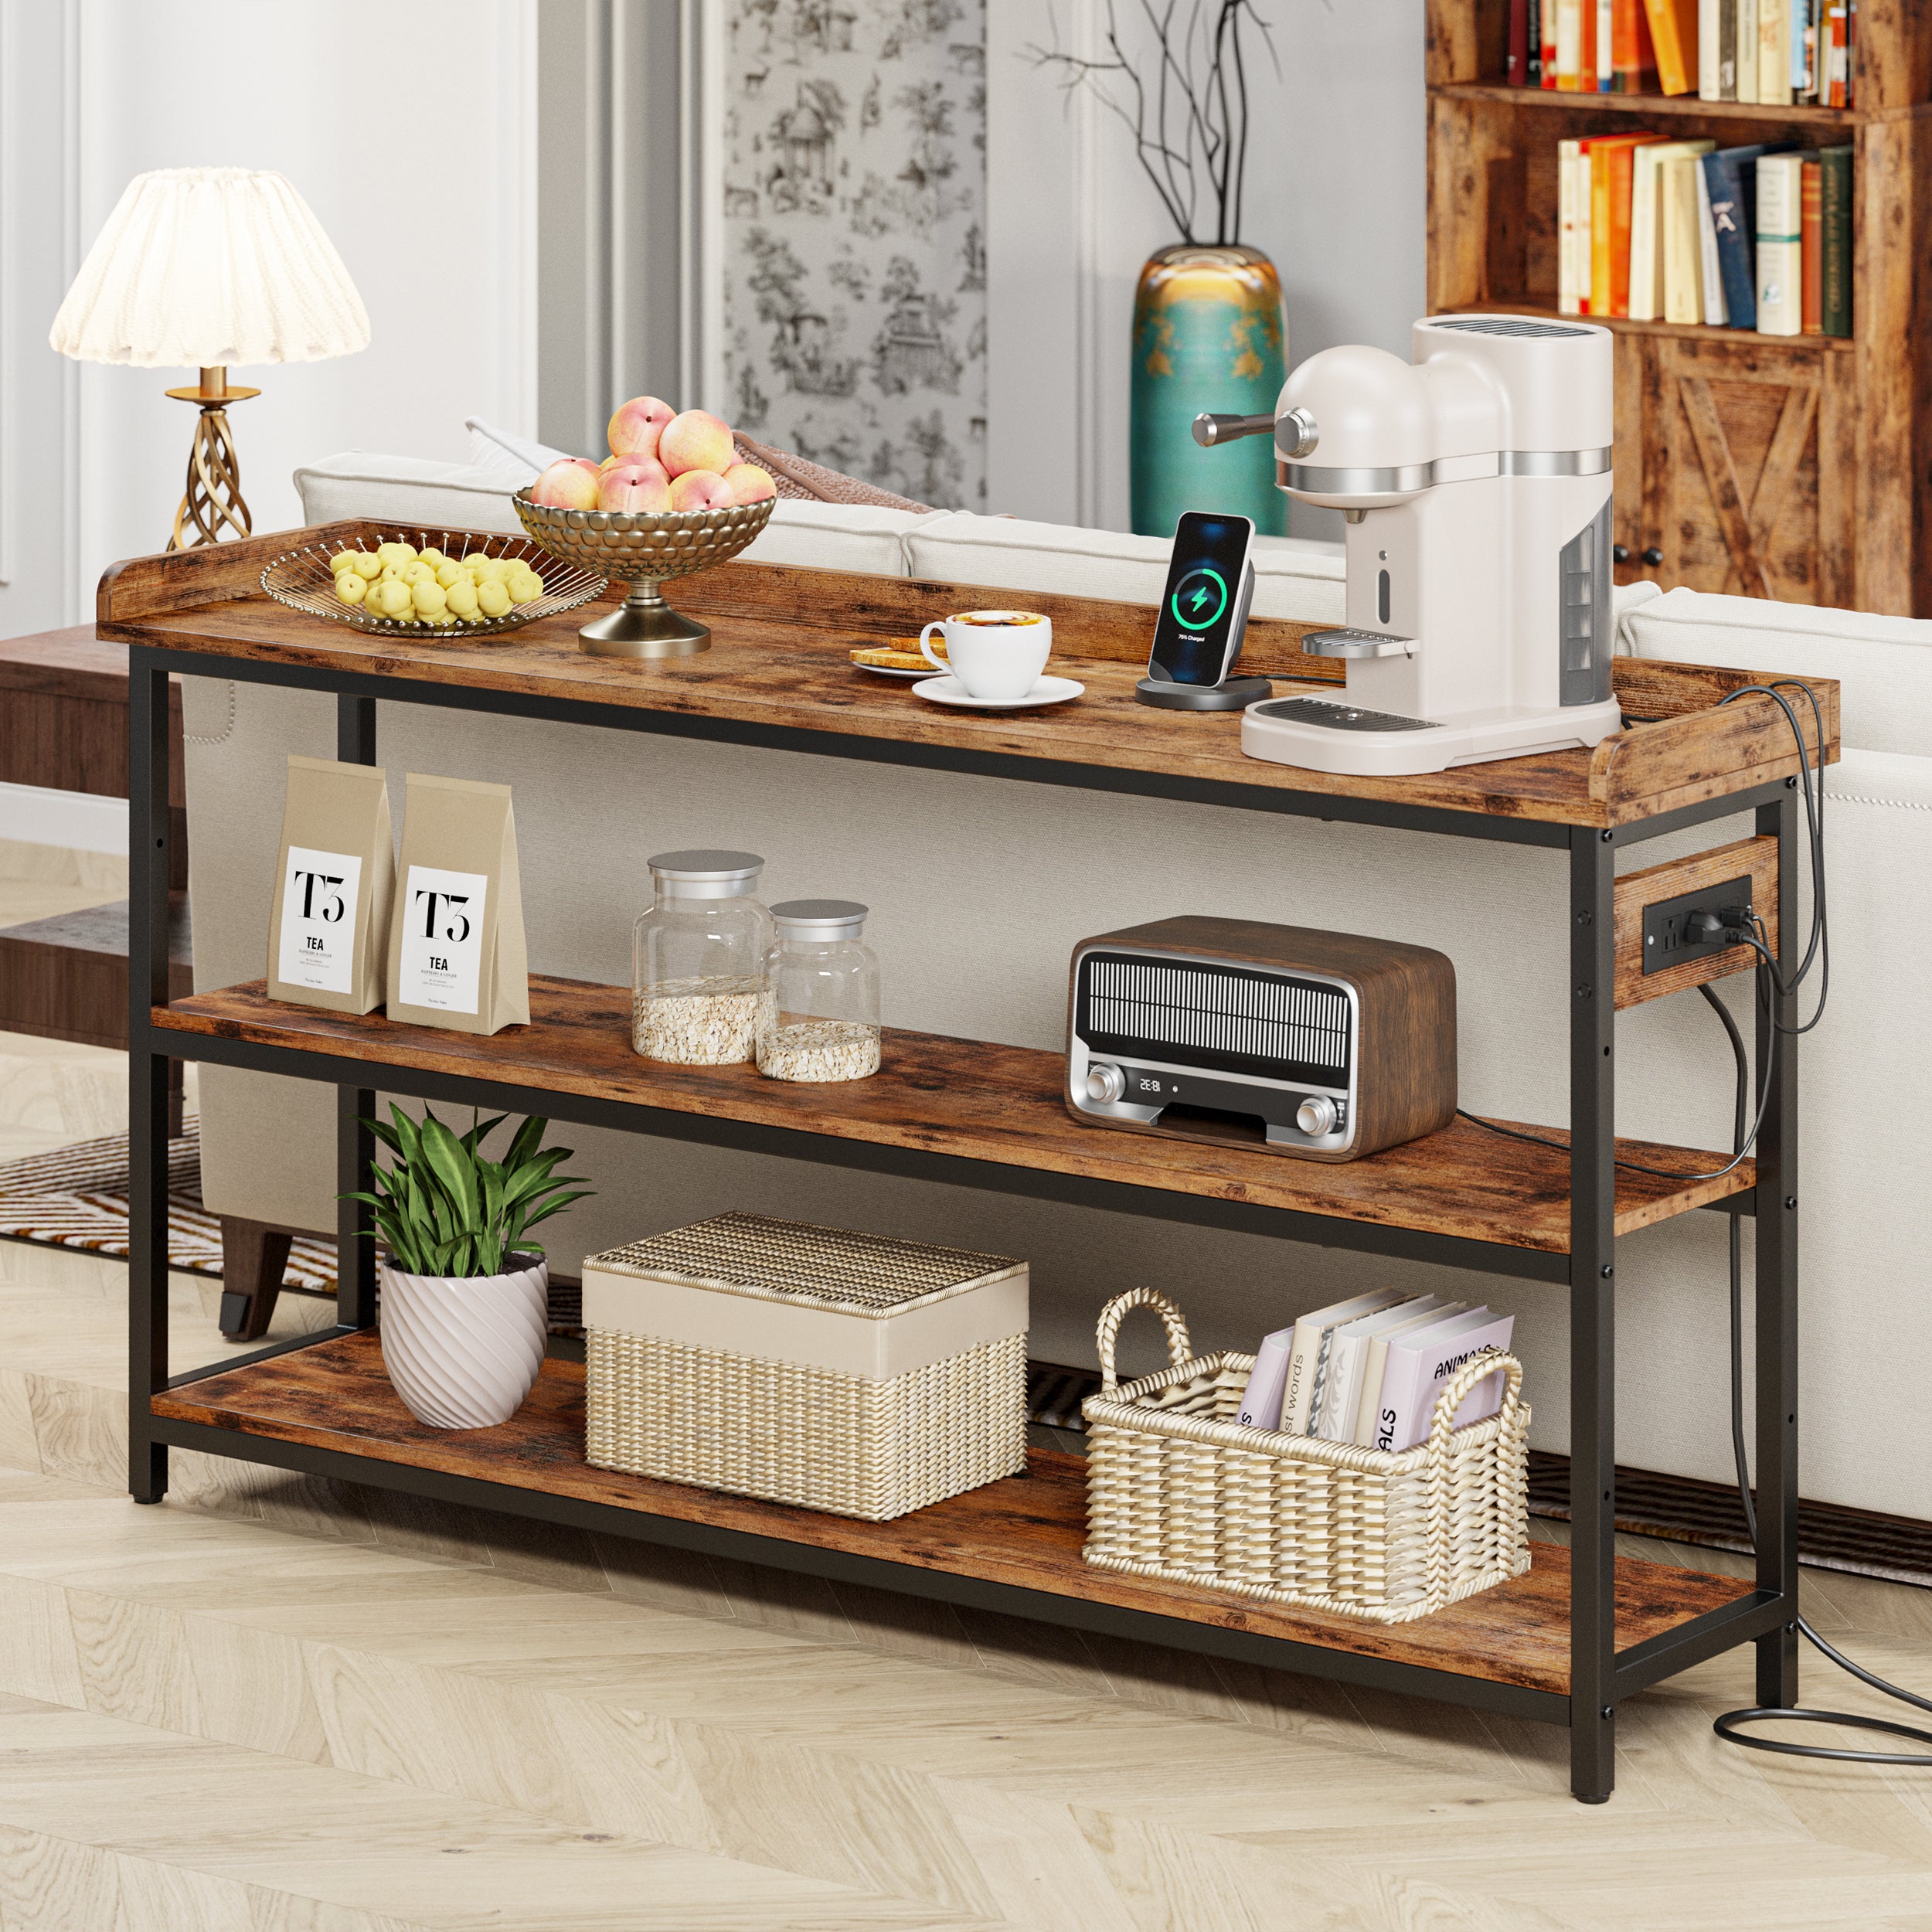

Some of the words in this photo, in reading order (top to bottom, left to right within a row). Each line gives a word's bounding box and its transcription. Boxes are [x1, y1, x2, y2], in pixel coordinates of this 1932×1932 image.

[294, 871, 345, 923] T3
[416, 890, 470, 942] T3
[306, 937, 324, 951] TEA
[429, 956, 448, 971] TEA
[1287, 1353, 1304, 1410] words
